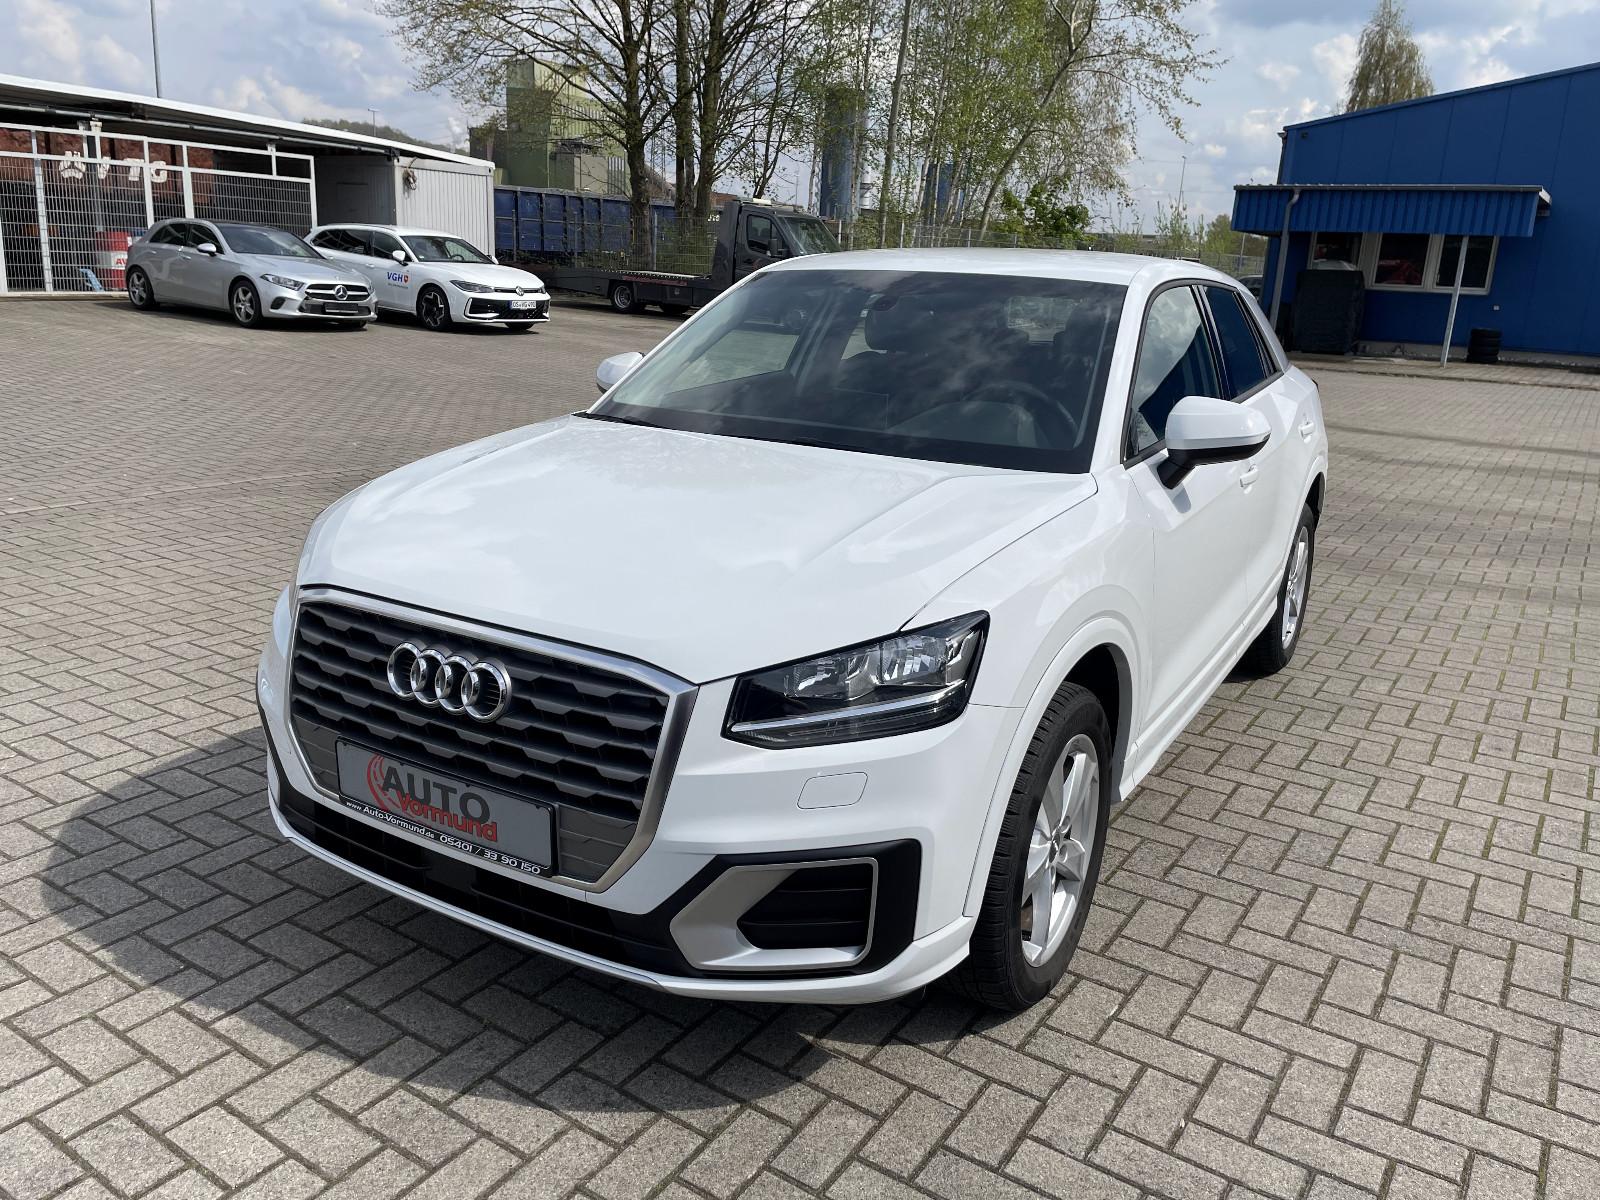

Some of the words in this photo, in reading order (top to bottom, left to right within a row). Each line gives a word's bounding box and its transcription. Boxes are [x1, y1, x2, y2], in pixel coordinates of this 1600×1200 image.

[386, 271, 403, 283] VGH
[382, 766, 490, 824] AUTO
[396, 790, 497, 842] Vormund
[440, 834, 472, 852] 05401
[483, 849, 498, 861] 33
[501, 855, 518, 867] 90
[521, 862, 541, 875] 150
